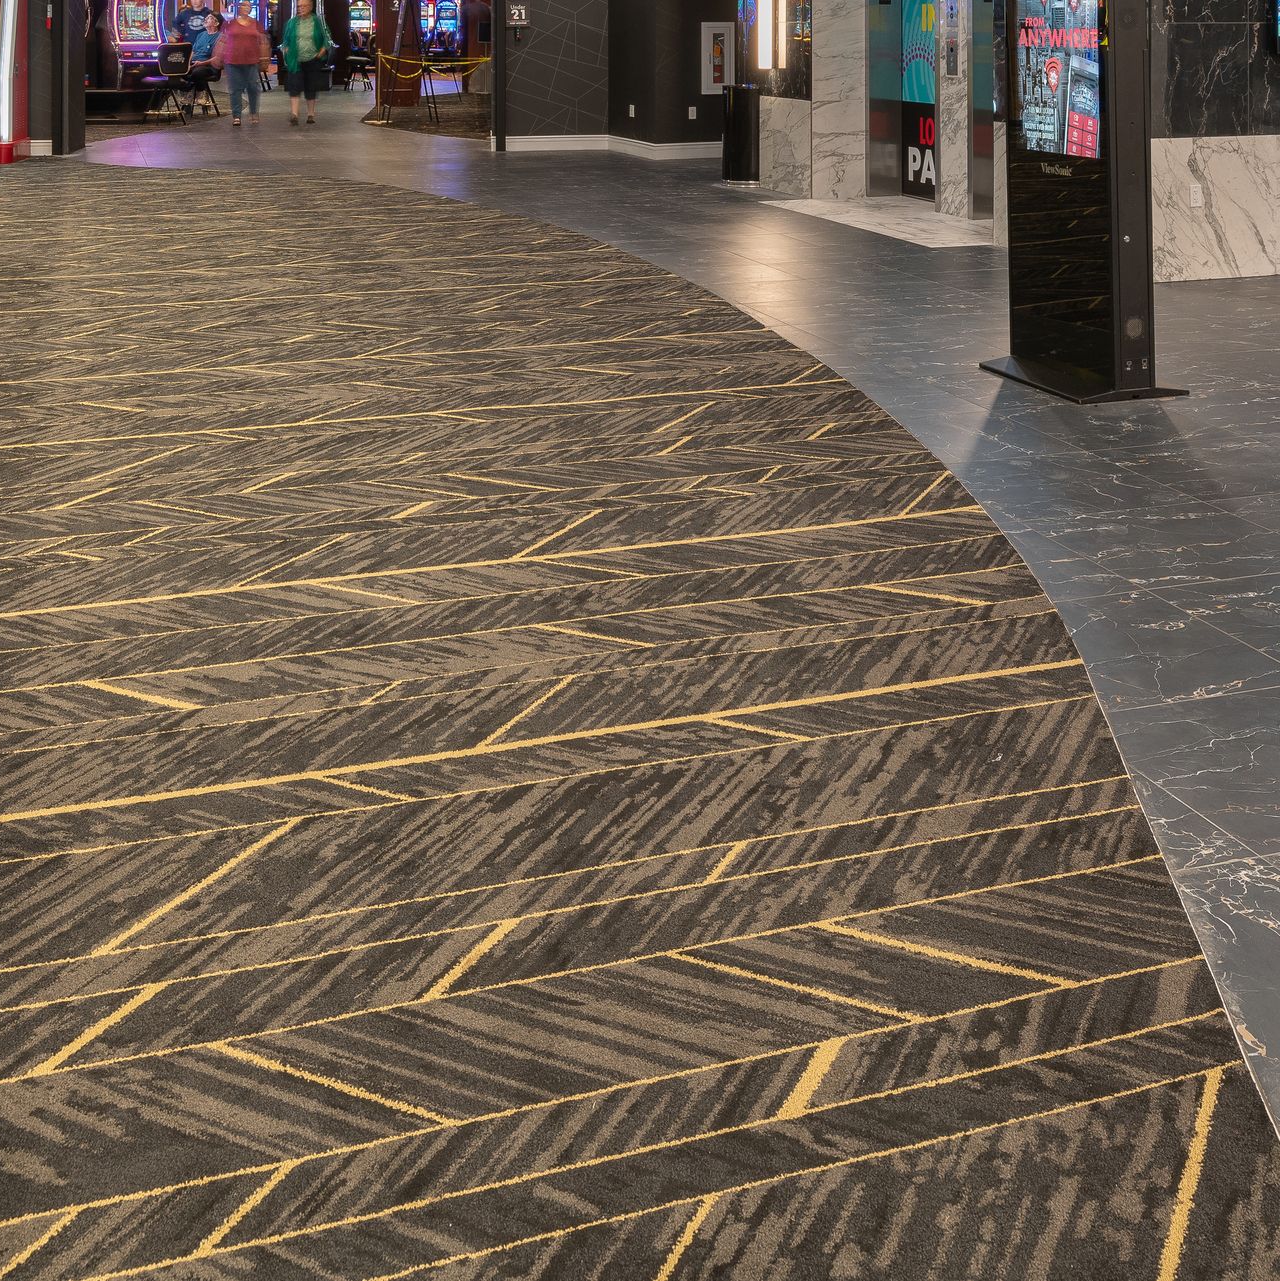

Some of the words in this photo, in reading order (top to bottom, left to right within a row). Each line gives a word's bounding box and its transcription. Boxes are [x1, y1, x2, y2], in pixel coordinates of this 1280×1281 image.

[511, 10, 525, 19] 21
[1025, 17, 1045, 27] FROM
[1018, 28, 1099, 48] ANYWHERE
[920, 117, 935, 145] LO
[908, 146, 936, 186] PA
[1041, 162, 1073, 177] ViewSonic
